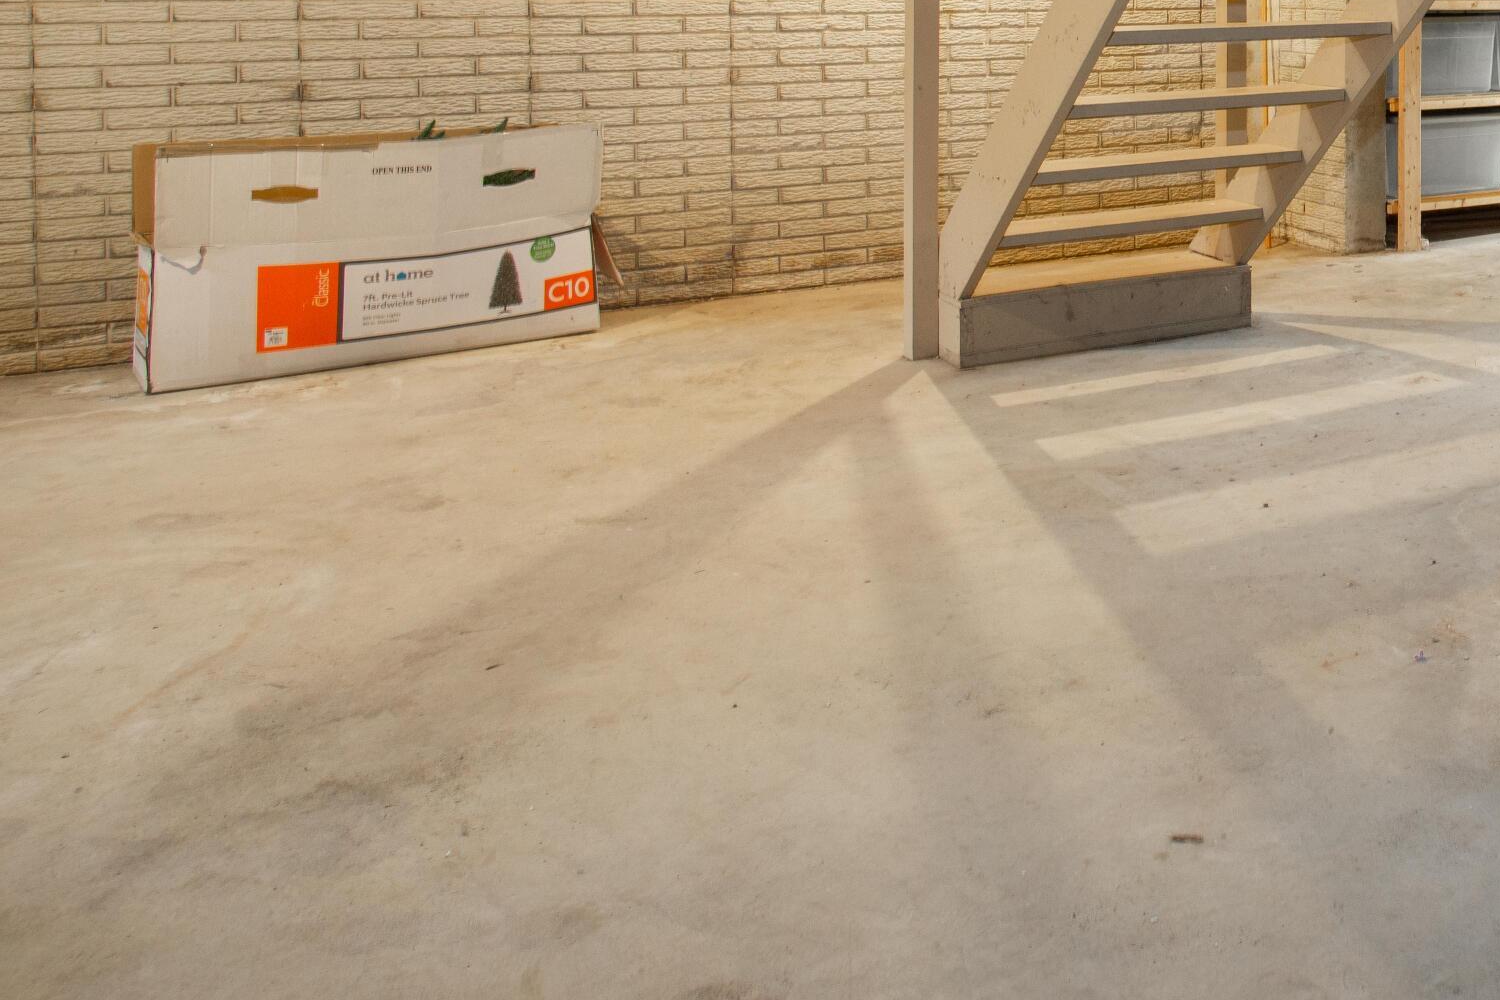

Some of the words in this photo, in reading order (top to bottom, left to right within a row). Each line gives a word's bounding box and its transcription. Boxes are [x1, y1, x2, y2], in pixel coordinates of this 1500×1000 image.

[372, 166, 394, 176] OPEN
[397, 165, 415, 174] THIS
[416, 165, 433, 174] END
[363, 272, 380, 284] at
[312, 267, 330, 308] Classic
[548, 276, 590, 303] C10
[416, 295, 447, 307] Spruce
[450, 291, 470, 300] Tree
